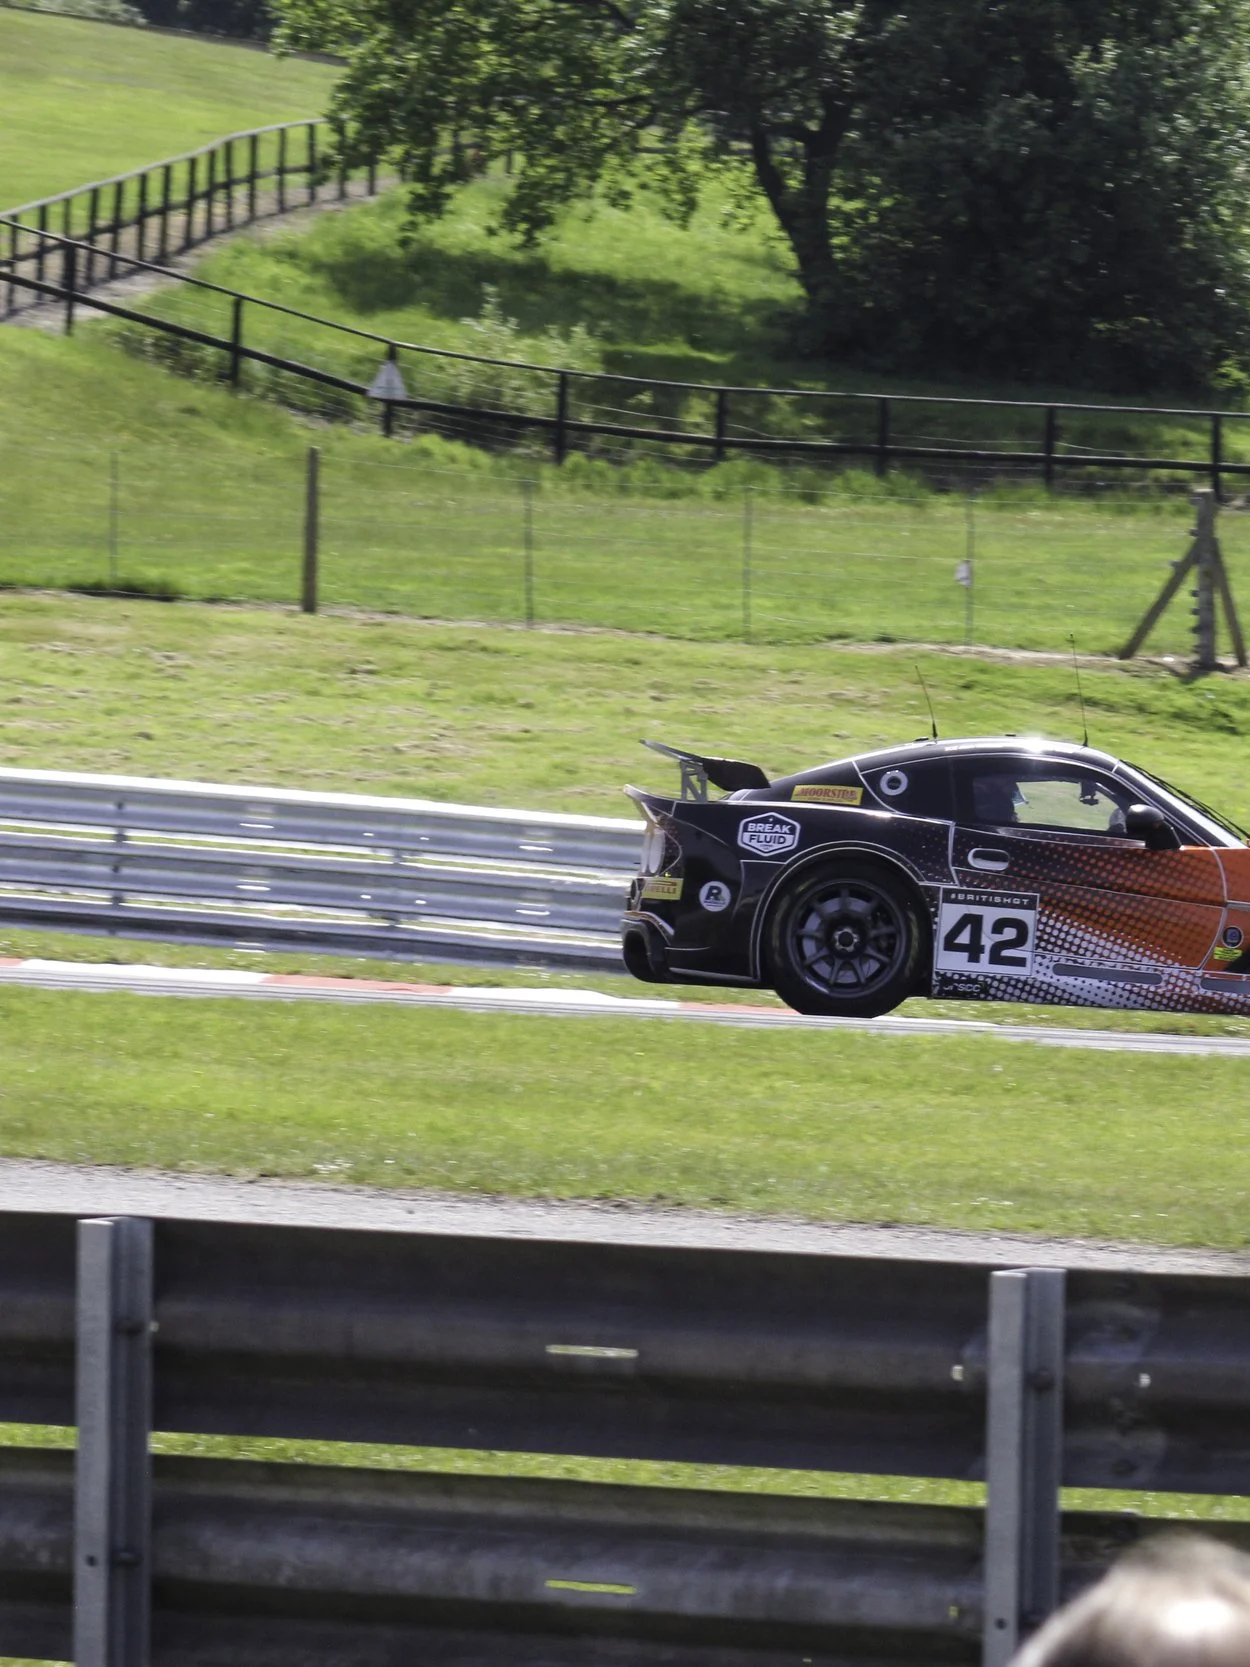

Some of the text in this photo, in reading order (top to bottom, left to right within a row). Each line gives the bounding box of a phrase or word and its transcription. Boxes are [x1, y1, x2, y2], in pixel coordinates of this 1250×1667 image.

[747, 822, 792, 834] BREAK
[749, 834, 787, 845] FLUID
[943, 912, 1029, 968] 42
